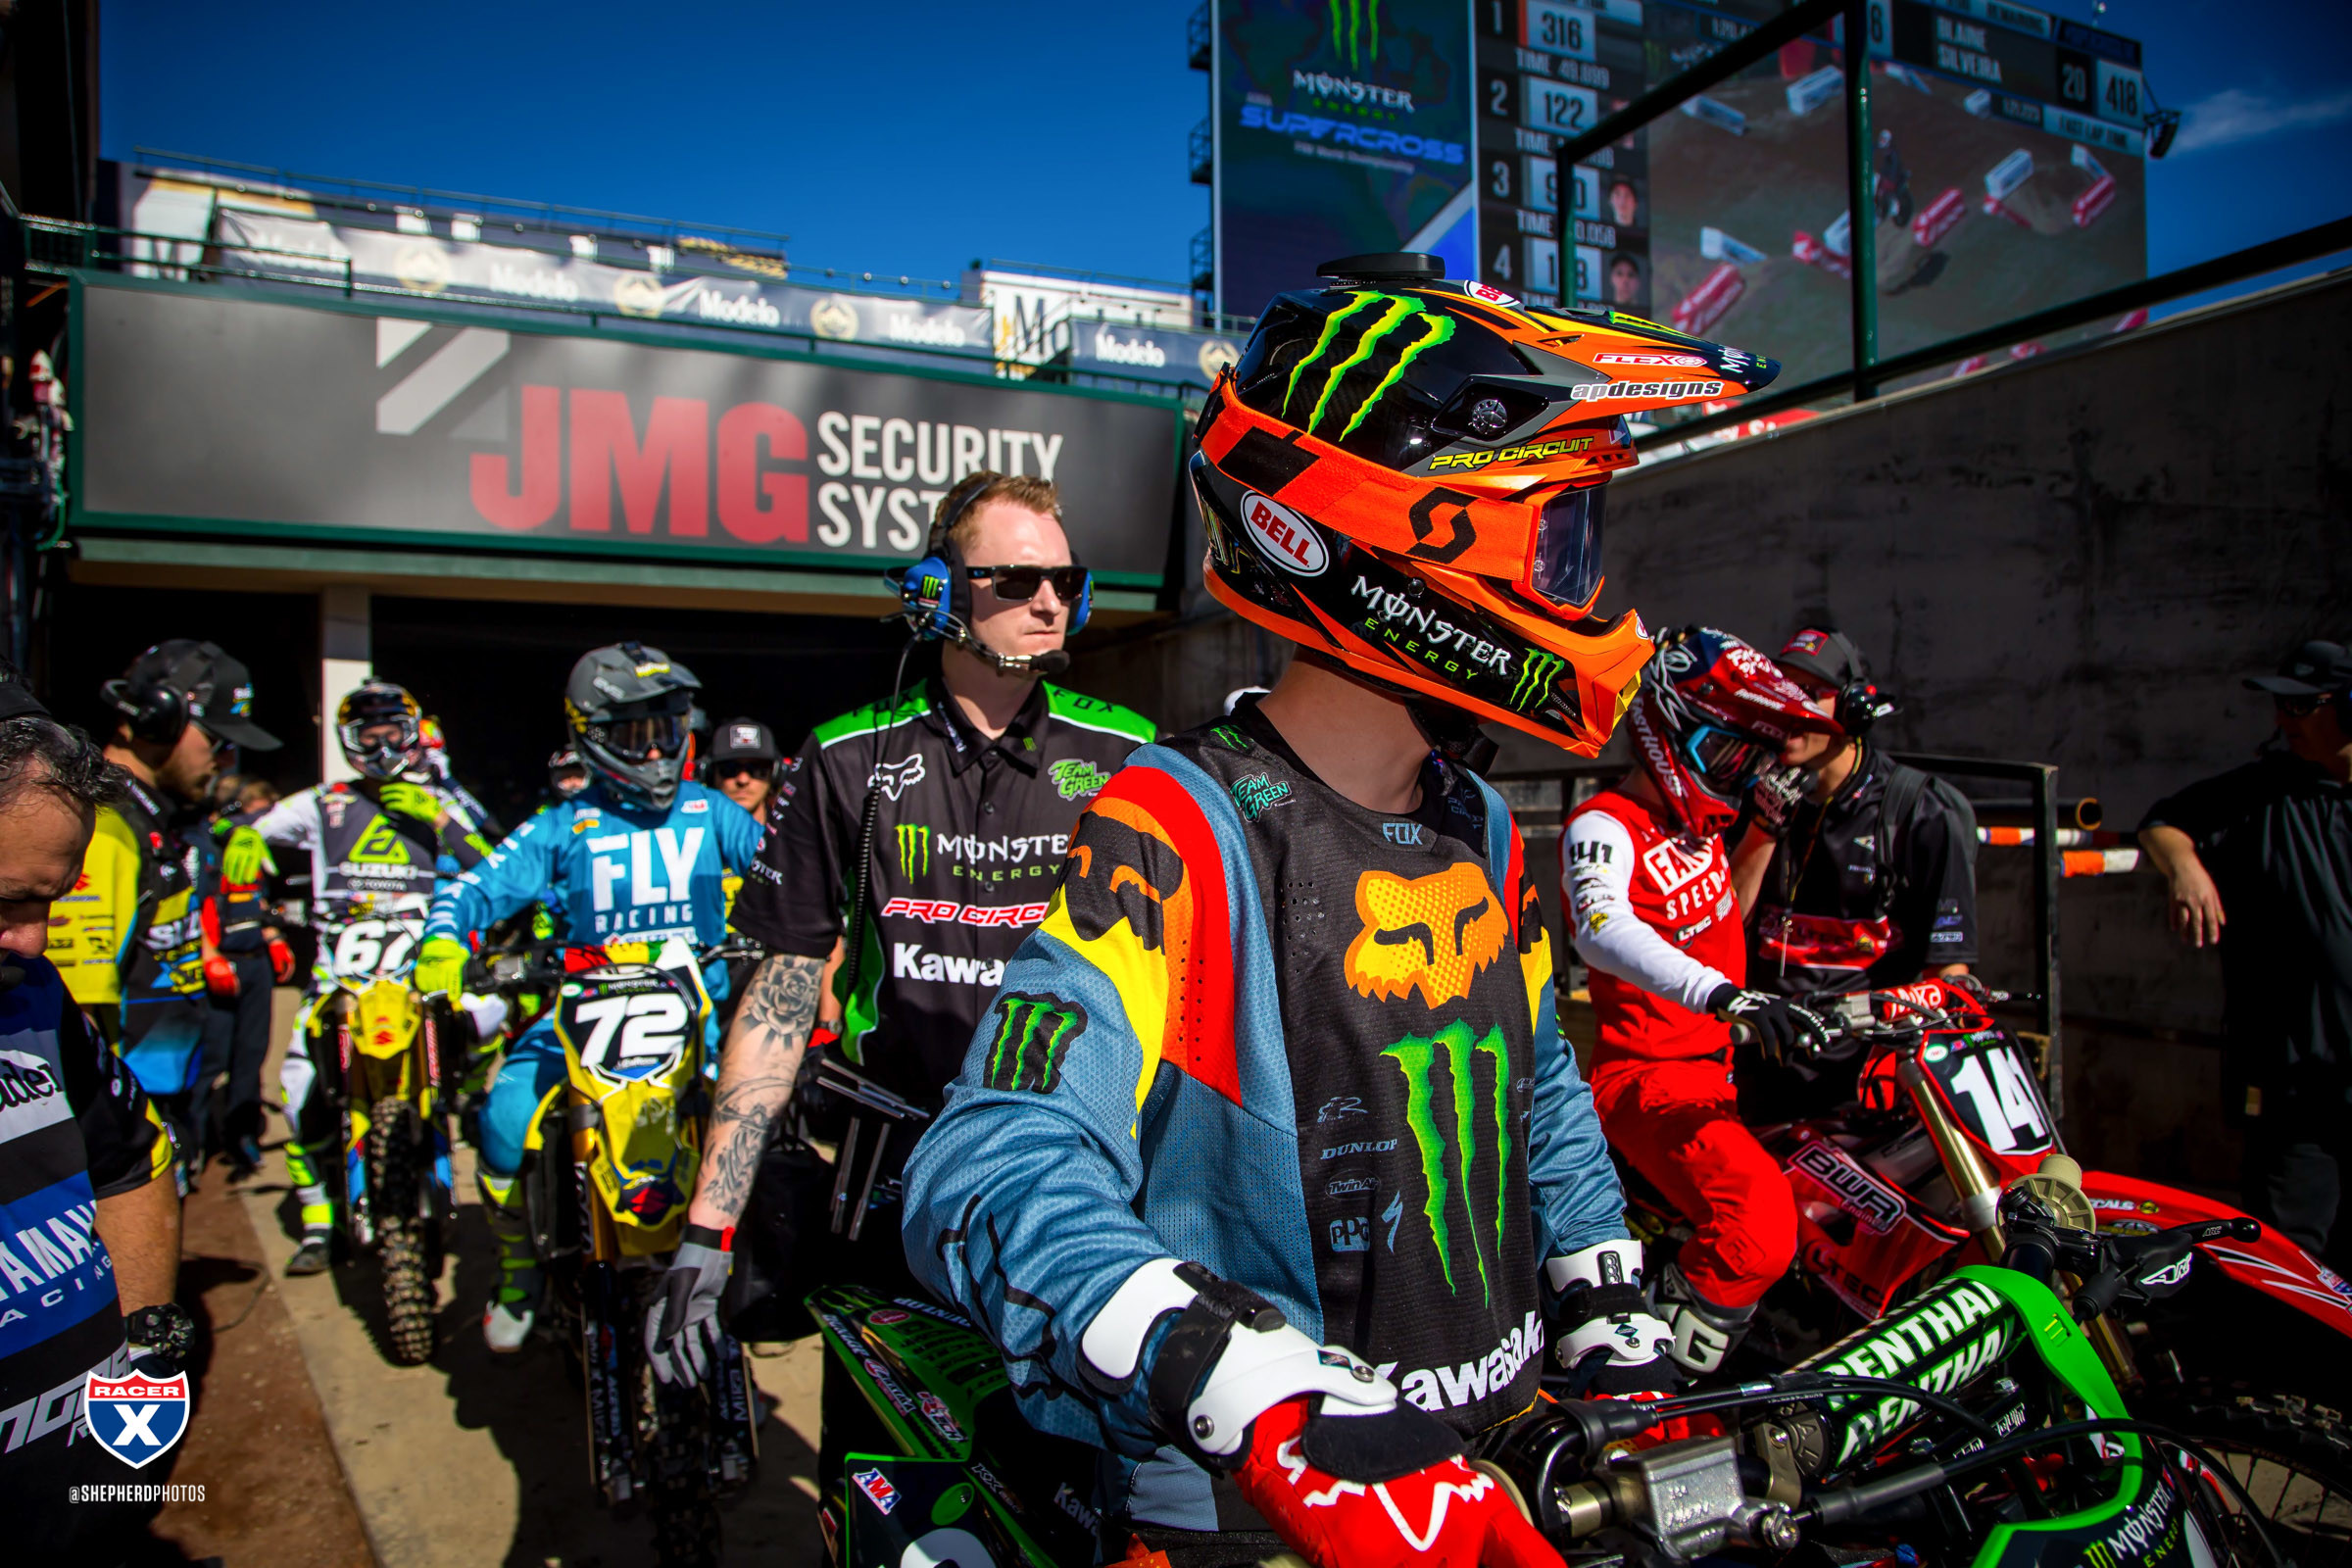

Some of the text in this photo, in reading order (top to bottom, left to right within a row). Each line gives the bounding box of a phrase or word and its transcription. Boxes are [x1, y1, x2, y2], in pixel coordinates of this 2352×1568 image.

[1542, 11, 1582, 51] 316
[1516, 48, 1551, 76] TIME
[1490, 79, 1584, 130] 2 122
[2105, 74, 2137, 117] 418
[1493, 161, 1510, 198] 3
[1517, 209, 1553, 236] TIME
[1493, 244, 1511, 281] 4
[699, 292, 780, 327] Modelo
[890, 313, 966, 347] Modelo
[1095, 331, 1165, 368] Modelo
[1572, 380, 1725, 402] apdesigns
[468, 386, 808, 544] JMG
[816, 411, 1063, 486] SECURITY
[1428, 437, 1594, 471] PRO CIRCUIT
[1250, 501, 1310, 567] BELL
[1350, 575, 1512, 676] MONSTER
[1365, 616, 1478, 681] ENERGY
[1053, 688, 1115, 713] FOX
[1051, 760, 1095, 782] TEAM
[1059, 773, 1110, 797] GREEN
[1230, 775, 1270, 808] TEAM
[1244, 782, 1290, 819] GREEN
[936, 833, 1073, 865] MONSTE
[1382, 822, 1424, 846] FOX
[586, 826, 706, 912] FLY
[953, 863, 1061, 882] ENERGY
[594, 904, 693, 933] RACING
[884, 899, 950, 922] PRO
[334, 919, 426, 977] 67
[893, 942, 1006, 988] Kawa
[574, 993, 688, 1068] 72
[1320, 1139, 1397, 1160] DUNLOP
[0, 1255, 113, 1329] ACING
[1380, 1310, 1545, 1412] awasak
[853, 1468, 902, 1515] AMA
